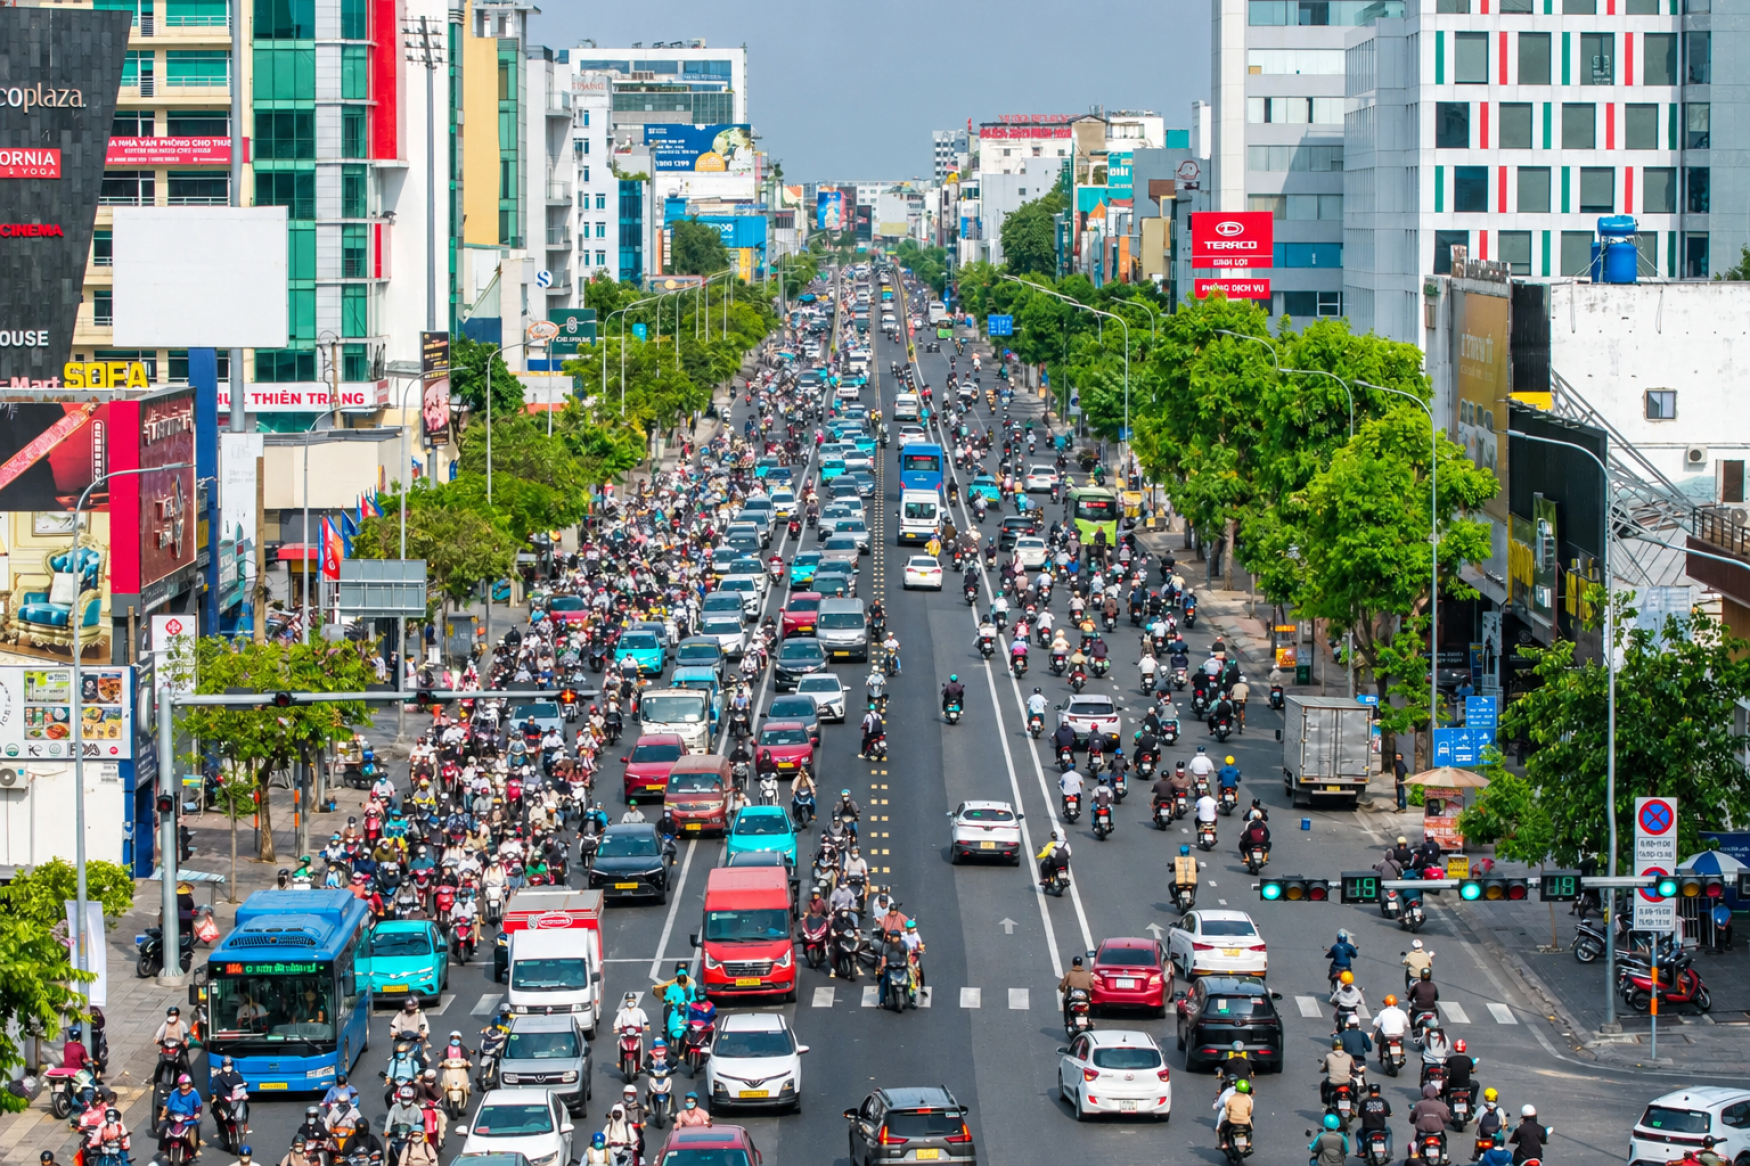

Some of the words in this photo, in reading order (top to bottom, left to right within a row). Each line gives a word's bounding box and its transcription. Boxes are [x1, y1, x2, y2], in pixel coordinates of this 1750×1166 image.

[0, 150, 56, 166] ORNIA
[0, 223, 65, 238] CINEMA
[1204, 241, 1257, 249] TERACO
[0, 330, 49, 347] OUSE
[64, 361, 150, 389] SOFA
[251, 389, 301, 405] THIÊN
